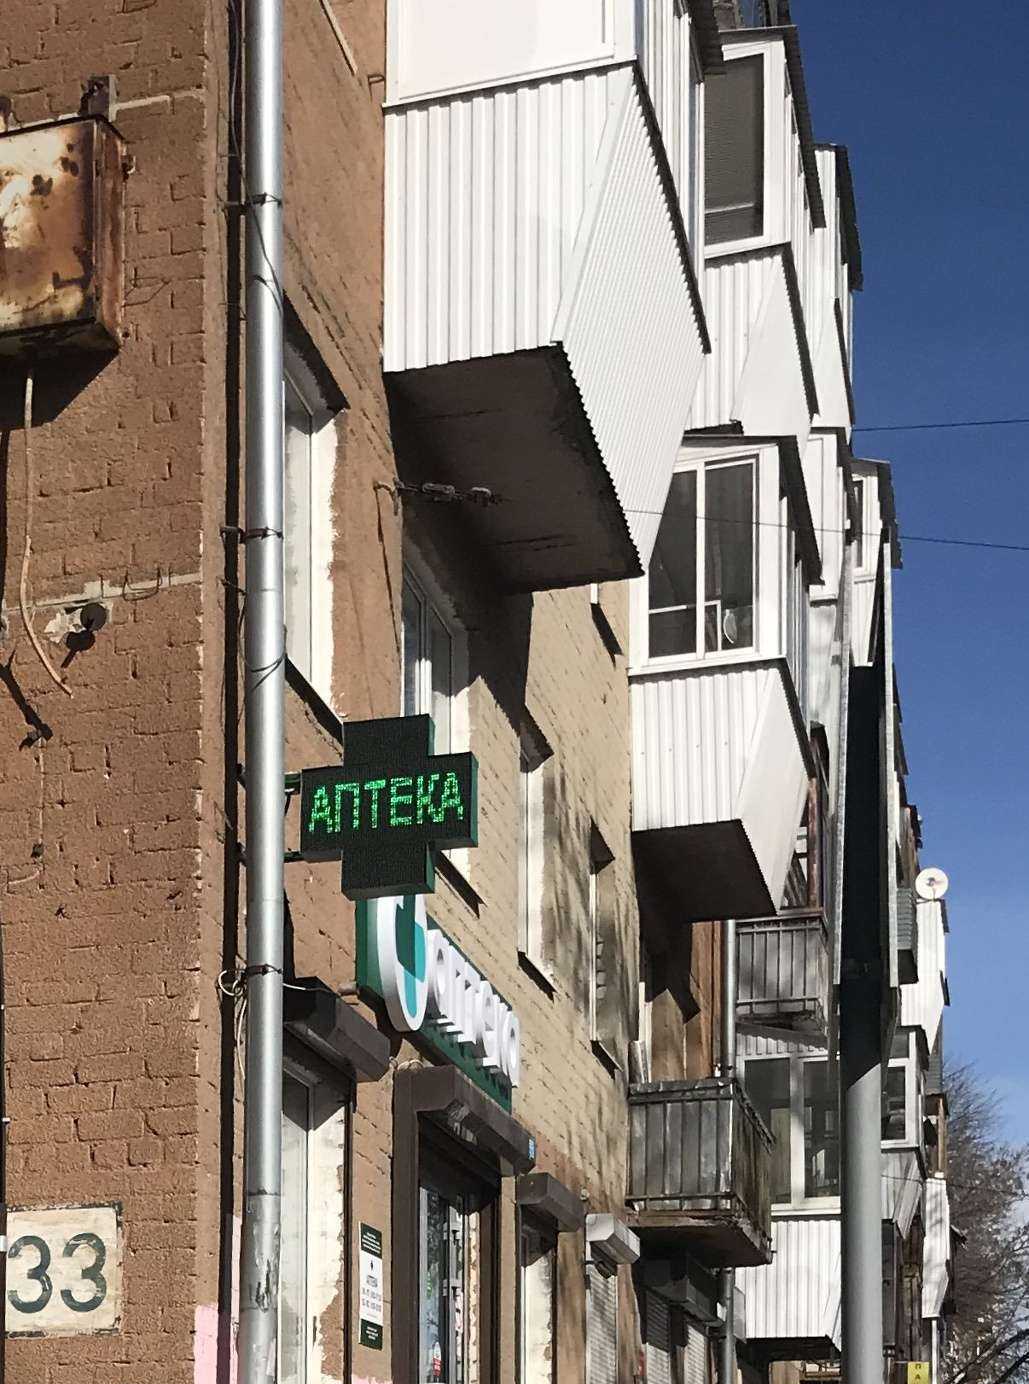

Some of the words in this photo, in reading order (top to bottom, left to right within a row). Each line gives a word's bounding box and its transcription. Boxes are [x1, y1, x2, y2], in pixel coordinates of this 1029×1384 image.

[308, 772, 464, 834] АПТЕКА
[427, 928, 520, 1088] аптека
[8, 1232, 107, 1313] 33
